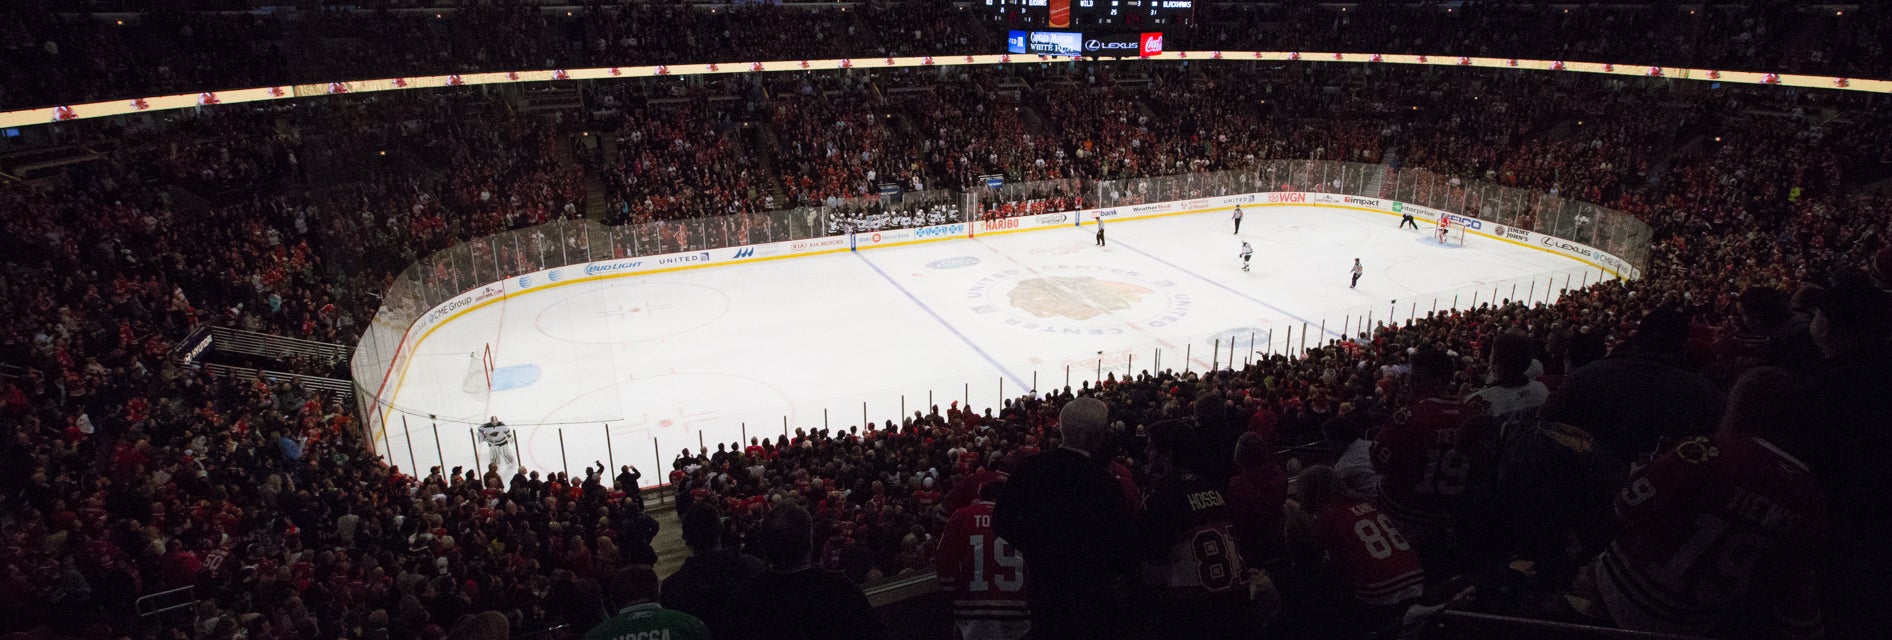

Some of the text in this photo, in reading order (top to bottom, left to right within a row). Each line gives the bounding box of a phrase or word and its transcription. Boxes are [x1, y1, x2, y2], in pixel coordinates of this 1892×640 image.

[1279, 192, 1306, 203] WGN
[1350, 197, 1380, 207] impact
[1100, 208, 1118, 217] bank
[1132, 204, 1172, 212] WeatherTech
[986, 219, 1019, 231] HARIBO
[1507, 226, 1530, 237] JIMMY
[1555, 242, 1592, 257] LEXUS
[659, 255, 698, 264] UNITED
[589, 261, 643, 272] BUD LIGHT
[433, 296, 473, 320] CME Group
[1186, 489, 1226, 511] HOSSA
[1354, 513, 1411, 560] 88
[969, 534, 1025, 592] 19
